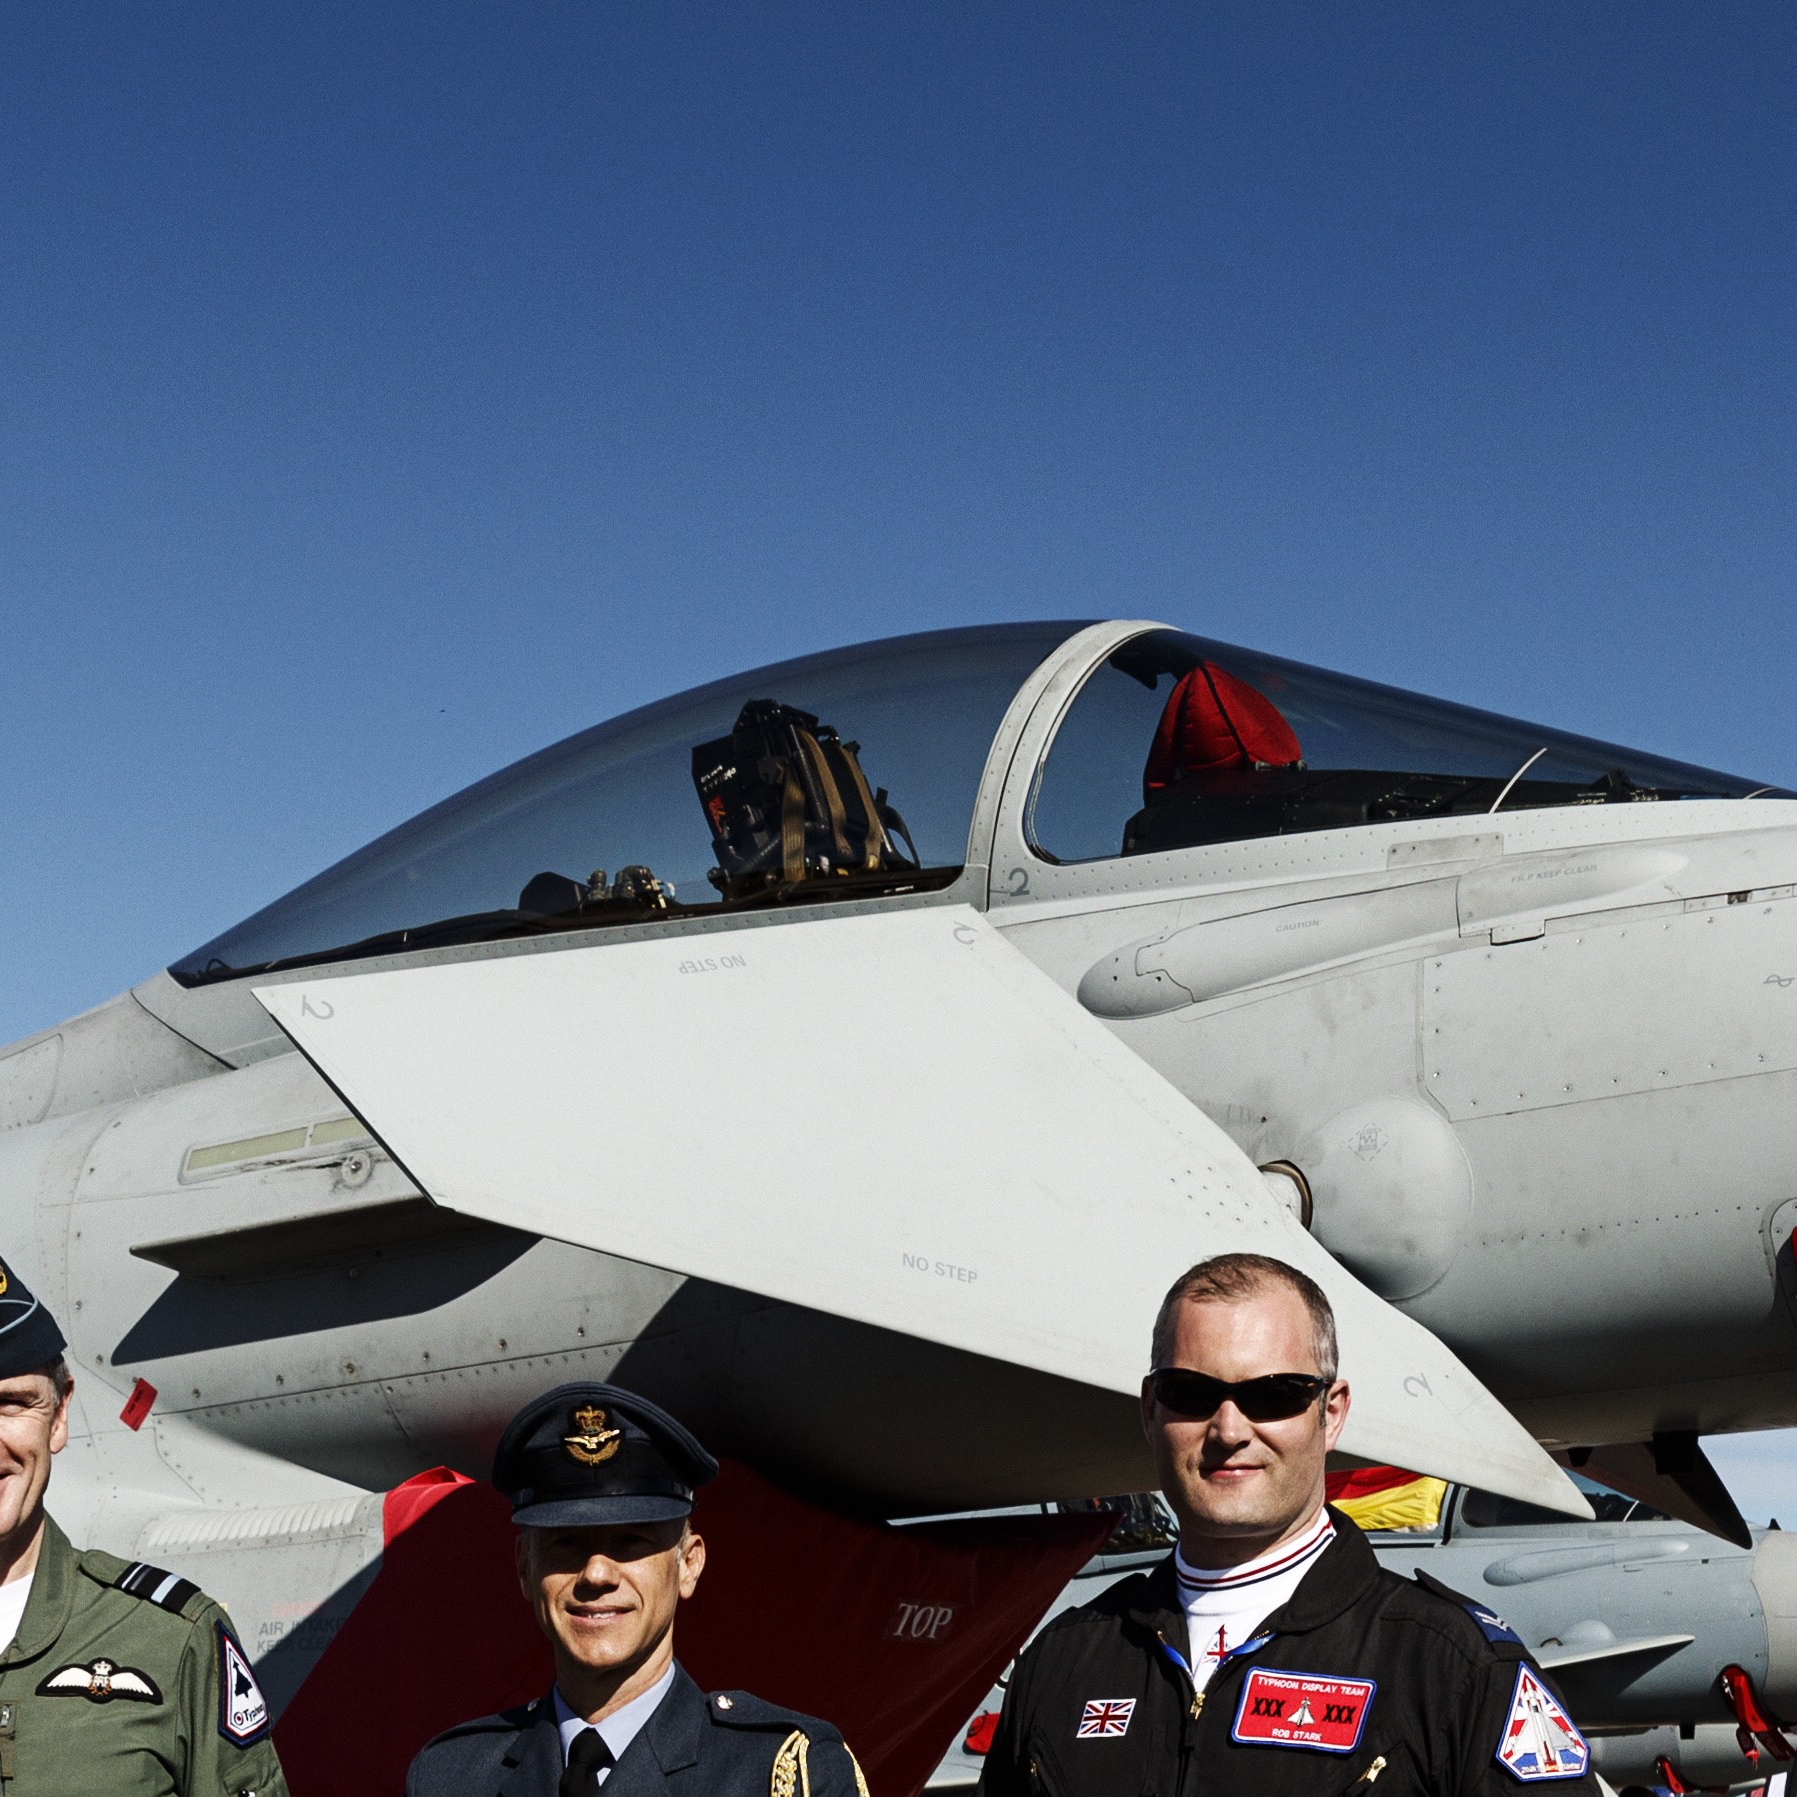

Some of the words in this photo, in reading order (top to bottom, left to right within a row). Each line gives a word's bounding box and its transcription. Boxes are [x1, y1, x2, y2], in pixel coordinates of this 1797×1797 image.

[1008, 867, 1030, 897] 2
[1275, 918, 1320, 933] CAUTION
[678, 958, 717, 974] STEP
[720, 954, 747, 969] NO
[903, 1252, 929, 1272] NO
[935, 1261, 978, 1284] STEP
[258, 1621, 285, 1637] AIR
[892, 1602, 953, 1639] TOP
[1258, 1676, 1299, 1690] TYPHOON
[1302, 1682, 1338, 1695] DISPLAY
[1341, 1686, 1366, 1697] TEAM
[1250, 1697, 1285, 1718] XXX
[1322, 1703, 1357, 1724] XXX
[1271, 1728, 1290, 1738] ROB
[1292, 1730, 1322, 1742] STARK
